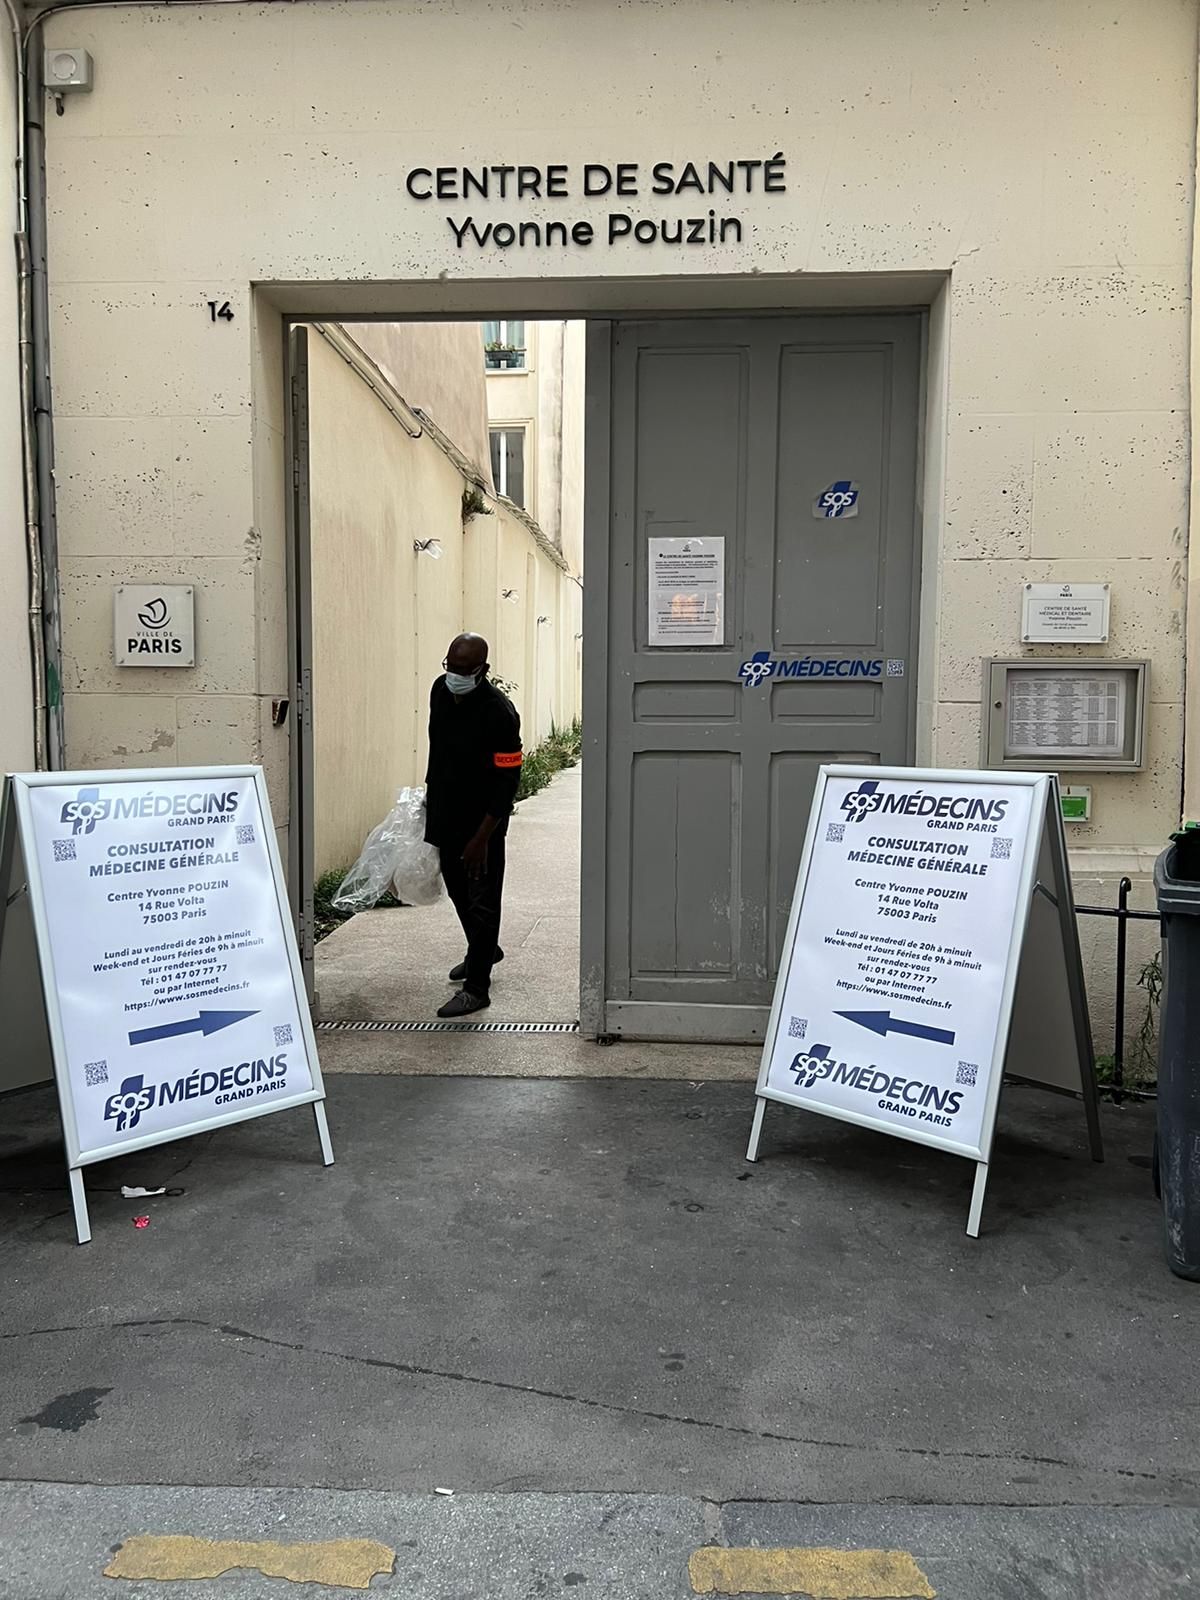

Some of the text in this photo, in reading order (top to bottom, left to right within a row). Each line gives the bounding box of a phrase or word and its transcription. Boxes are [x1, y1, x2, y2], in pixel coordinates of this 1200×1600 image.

[406, 152, 787, 199] CENTRE DE SANTÉ
[446, 210, 742, 249] Yvonne Pouzin
[207, 301, 235, 322] 14
[822, 492, 854, 507] SOS
[128, 639, 182, 653] PARIS
[742, 656, 883, 677] SOS MÉDECINS
[66, 791, 239, 820] SOS MÉDECINS
[846, 790, 1009, 822] SOS MÉDECINS
[168, 815, 236, 827] GRAND PARIS
[927, 819, 998, 833] GRAND PARIS
[107, 837, 215, 857] CONSULTATION
[868, 836, 968, 856] CONSULTATION
[89, 851, 239, 877] MÉDECINE GÉNÉRALE
[847, 850, 988, 876] MÉDECINE GÉNÉRALE
[107, 880, 229, 902] Centre Yvonne POUZIN
[855, 878, 968, 900] Centre Yvonne POUZIN
[138, 897, 205, 912] 14 Rue Volta
[878, 894, 940, 910] 14 Rue Volta
[143, 908, 207, 925] 75003 Paris
[877, 906, 937, 923] 75003 Paris
[104, 949, 130, 960] Lundi
[144, 941, 184, 953] vendredi
[186, 939, 197, 947] de
[199, 935, 216, 945] 20h
[217, 934, 222, 942] à
[224, 929, 252, 940] minuit
[824, 936, 863, 949] Week-end
[873, 946, 895, 955] Jours
[896, 949, 921, 960] Féries
[922, 954, 933, 962] de
[934, 956, 945, 965] 9h
[953, 960, 982, 971] minuit
[836, 928, 858, 939] Lundi
[859, 933, 869, 941] au
[870, 935, 906, 947] vendredi
[907, 941, 918, 949] de
[919, 942, 936, 951] 20h
[944, 947, 972, 958] minuit
[93, 958, 139, 972] Week-end
[141, 956, 150, 964] et
[151, 953, 176, 963] Jours
[178, 949, 203, 960] Féries
[205, 946, 216, 954] de
[218, 943, 229, 951] 9h
[237, 937, 264, 948] minuit
[148, 956, 218, 974] sur rendez-vous
[880, 957, 931, 972] rendez-vous
[141, 978, 154, 987] Tél
[161, 974, 173, 983] 01
[175, 972, 186, 980] 47
[189, 970, 201, 978] 07
[203, 967, 215, 975] 77
[217, 964, 228, 972] 77
[858, 963, 869, 972] Tél
[874, 966, 885, 974] 01
[887, 969, 898, 977] 47
[900, 971, 911, 979] 07
[913, 974, 924, 982] 77
[926, 976, 938, 984] 77
[124, 980, 250, 1012] https://www.sosmedecins.fr
[167, 985, 182, 995] par
[184, 976, 219, 991] Internet
[836, 979, 952, 1010] https://www.sosmedecins.fr
[876, 978, 890, 987] par
[892, 980, 926, 993] Internet
[109, 1053, 288, 1117] SOS MÉDECINS
[214, 1079, 287, 1105] GRAND PARIS
[795, 1055, 964, 1114] SOS MÉDECINS
[878, 1100, 953, 1127] GRAND PARIS
